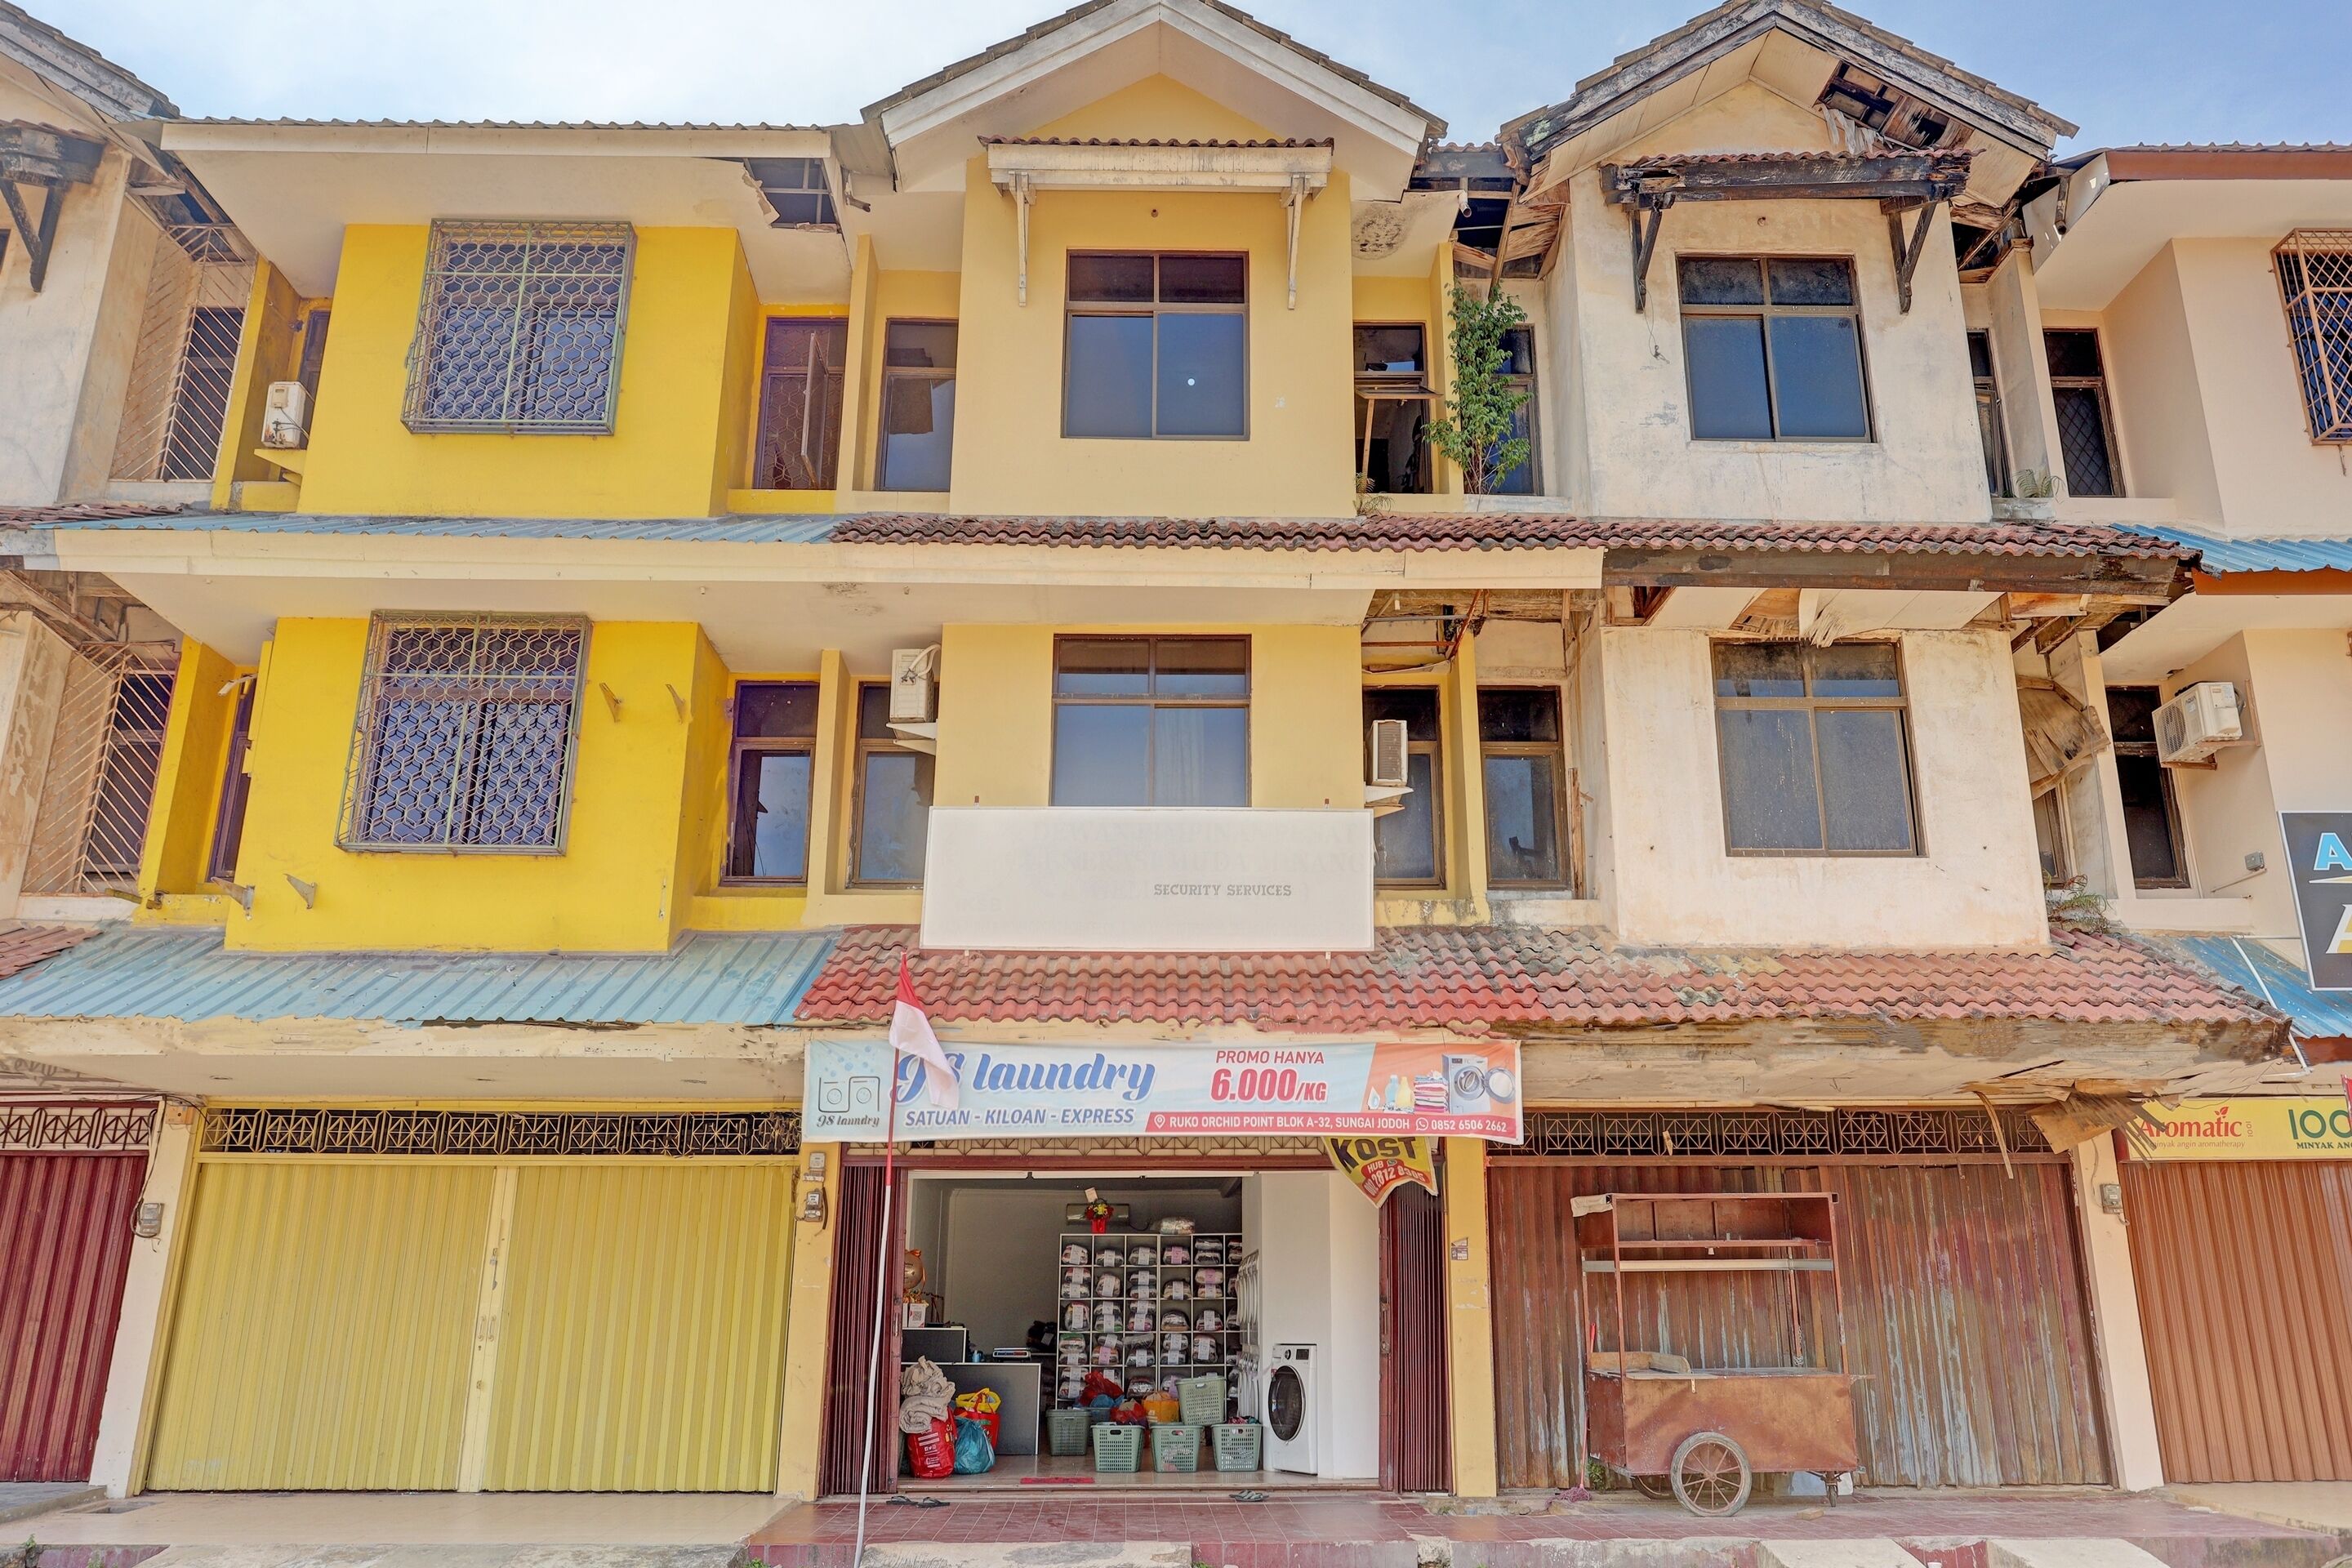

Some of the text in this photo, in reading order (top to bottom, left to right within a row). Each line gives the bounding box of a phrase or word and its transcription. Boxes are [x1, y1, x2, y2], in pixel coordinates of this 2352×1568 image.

[1153, 884, 1221, 896] SECURITY
[1227, 884, 1292, 897] SERVICES
[1216, 1050, 1325, 1064] PROMO HANYA
[973, 1053, 1156, 1101] laundry
[836, 1114, 880, 1128] laundry
[906, 1111, 971, 1126] SATUAN
[985, 1109, 1046, 1125] KILOAN
[1061, 1108, 1134, 1124] EXPRESS
[1169, 1116, 1199, 1128] RUKO
[1201, 1116, 1241, 1128] ORCHID
[1243, 1116, 1274, 1128] POINT
[1276, 1116, 1304, 1128] BLOK
[1335, 1117, 1374, 1129] SUNGAI
[1377, 1118, 1410, 1129] JODOH
[1432, 1120, 1455, 1131] 0852
[1459, 1120, 1483, 1130] 6506
[1486, 1120, 1508, 1133] 2662
[2177, 1141, 2196, 1150] angin
[2198, 1139, 2246, 1150] aromatherapy
[1330, 1137, 1416, 1174] KOST
[1367, 1160, 1384, 1174] HUB
